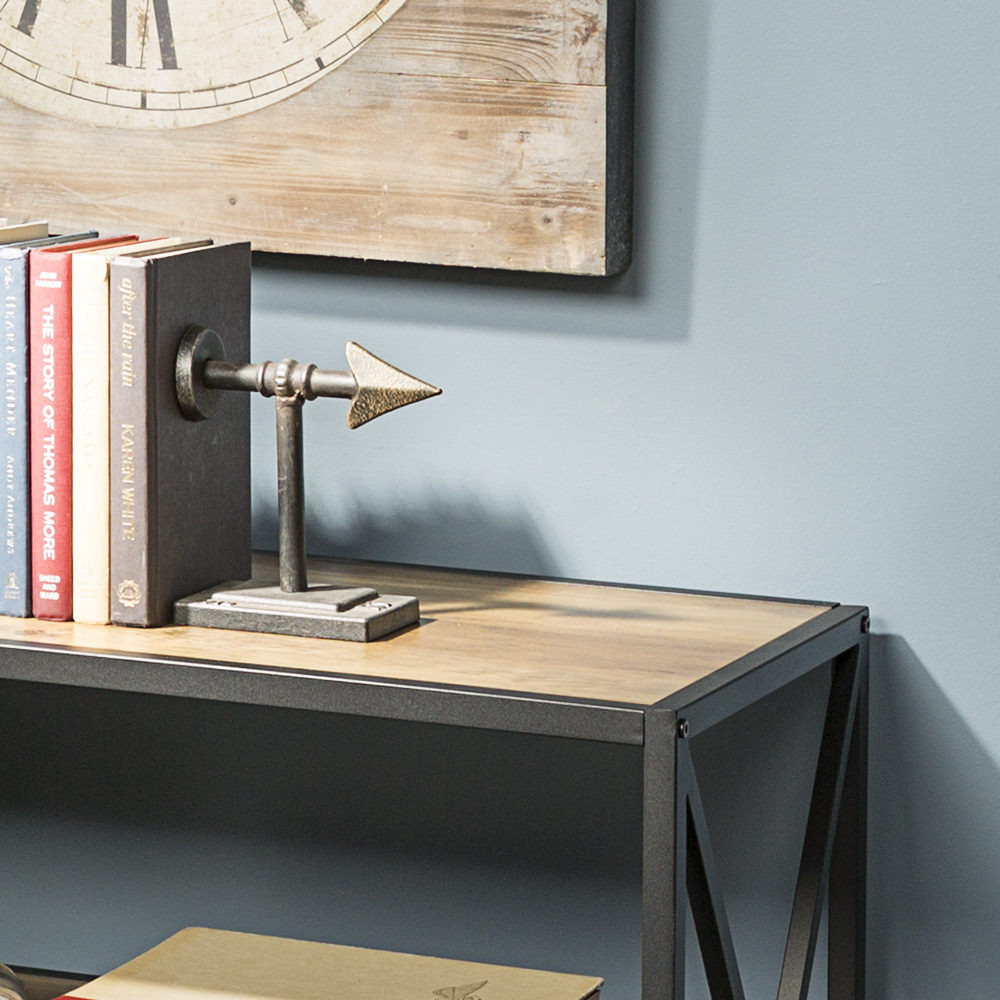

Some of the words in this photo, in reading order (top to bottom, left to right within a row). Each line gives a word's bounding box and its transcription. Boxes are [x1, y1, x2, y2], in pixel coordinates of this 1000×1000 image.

[4, 295, 17, 354] HEART
[42, 304, 54, 339] THE
[118, 277, 137, 320] after
[121, 322, 137, 351] the
[42, 343, 55, 401] STORY
[121, 353, 136, 388] rain
[5, 361, 17, 437] MENDER
[42, 405, 55, 430] OF
[6, 455, 15, 490] ANDY
[43, 434, 55, 505] THOMAS
[120, 424, 135, 485] KAREN
[6, 494, 15, 555] ANDREWS
[43, 511, 56, 561] MORE
[121, 487, 135, 541] WHITE
